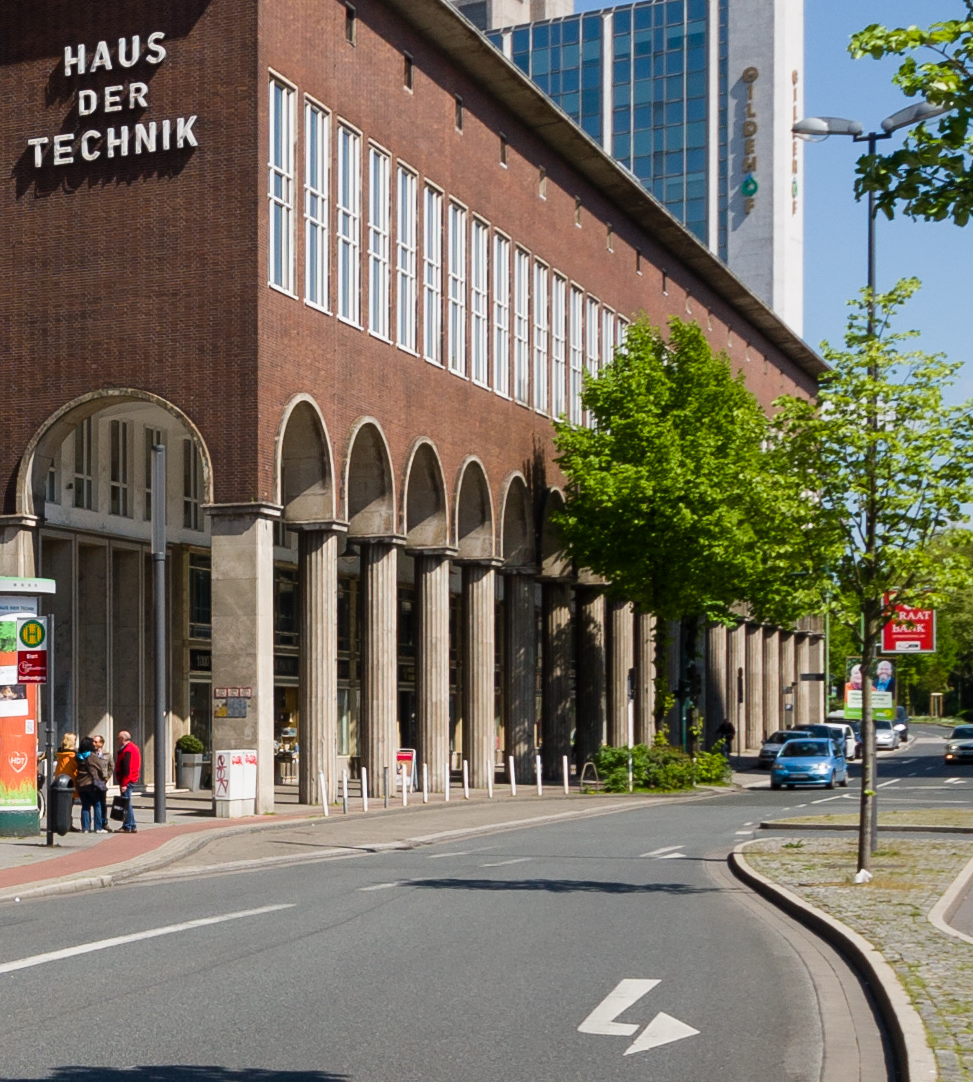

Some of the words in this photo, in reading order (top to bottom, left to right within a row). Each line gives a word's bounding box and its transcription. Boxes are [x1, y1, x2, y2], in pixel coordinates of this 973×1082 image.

[64, 31, 167, 77] HAUS
[78, 81, 149, 117] DER
[27, 115, 199, 168] TECHNIK
[741, 66, 759, 215] GILDEHOF
[11, 757, 25, 765] HDT
